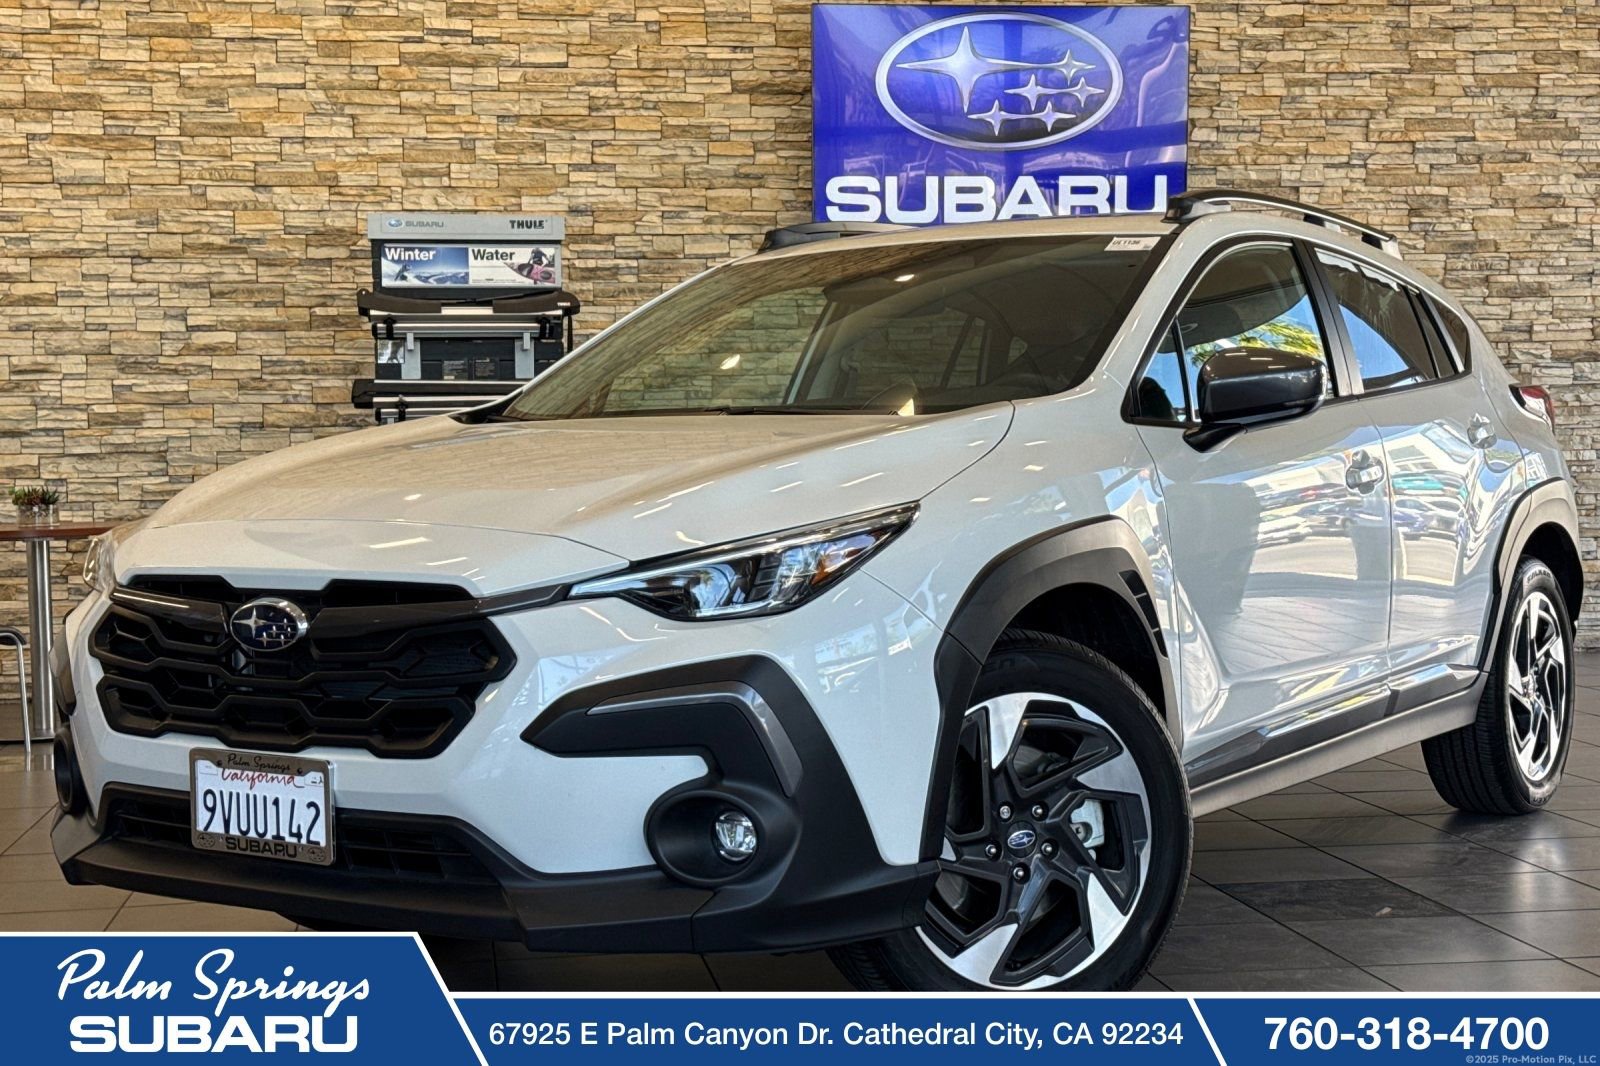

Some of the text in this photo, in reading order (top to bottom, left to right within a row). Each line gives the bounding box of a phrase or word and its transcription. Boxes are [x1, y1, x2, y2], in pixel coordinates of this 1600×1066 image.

[825, 175, 1168, 224] SUBARU
[405, 220, 444, 228] SUBARU
[509, 219, 544, 229] THULE
[384, 247, 436, 261] Winter
[471, 248, 516, 261] Water
[227, 753, 291, 773] Palm Springs
[221, 767, 305, 791] California
[203, 788, 321, 846] 9VUU142
[225, 836, 297, 859] SUBARU
